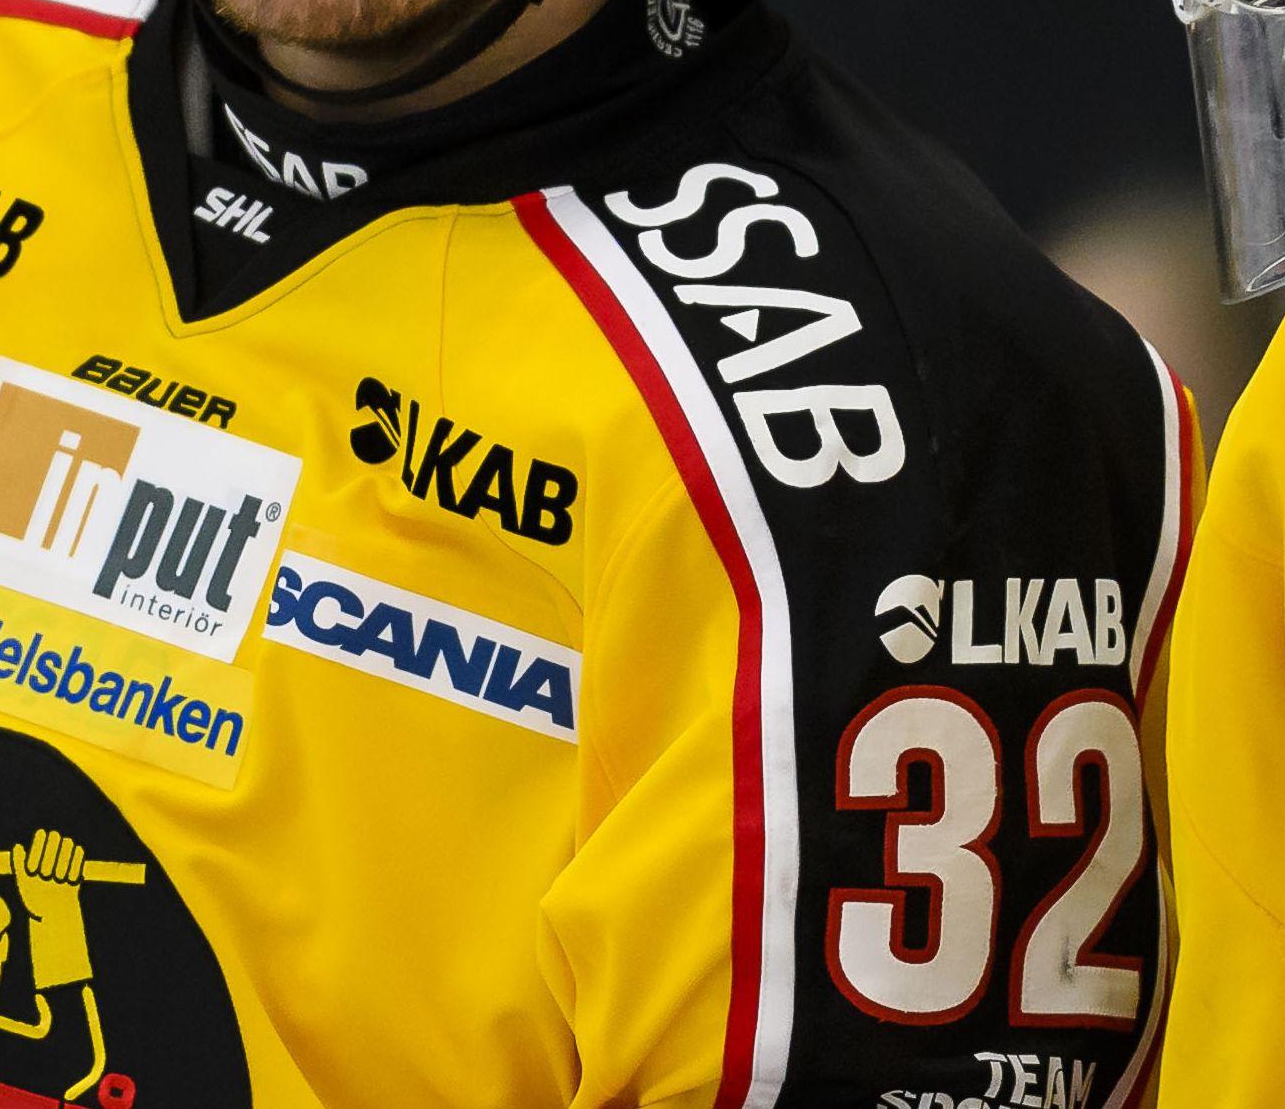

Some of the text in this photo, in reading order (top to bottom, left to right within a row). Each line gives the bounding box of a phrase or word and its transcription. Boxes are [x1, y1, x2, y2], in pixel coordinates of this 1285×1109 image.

[193, 186, 274, 245] SHL
[603, 162, 907, 489] SSAB
[70, 354, 238, 429] BAUER
[22, 429, 263, 613] input
[119, 584, 223, 637] interiör
[265, 565, 575, 731] SCANIA
[950, 577, 1127, 666] LKAB
[824, 684, 1148, 1032] 32
[973, 1051, 1097, 1109] TEAM
